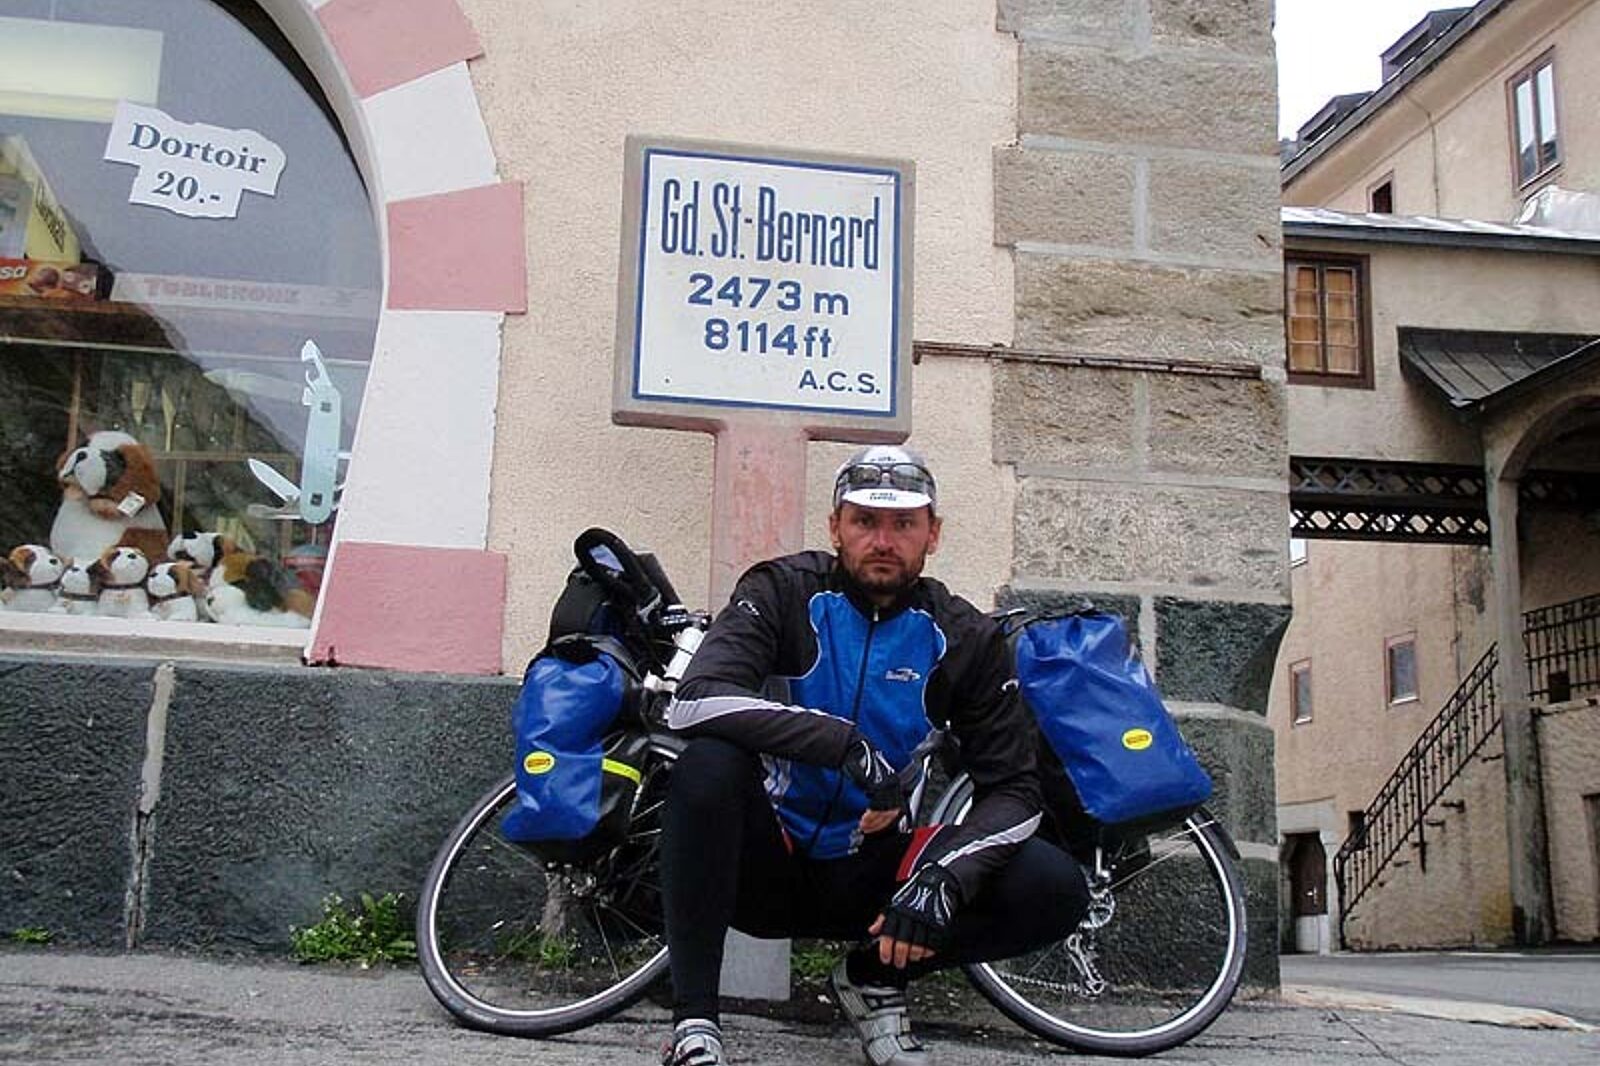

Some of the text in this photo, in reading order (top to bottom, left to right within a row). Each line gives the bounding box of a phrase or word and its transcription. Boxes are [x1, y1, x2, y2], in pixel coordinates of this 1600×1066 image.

[128, 122, 267, 174] Dortoir
[151, 170, 221, 204] 20.-
[660, 178, 704, 257] Gd.
[687, 272, 850, 316] 2473 m
[798, 369, 881, 395] A.C.S.
